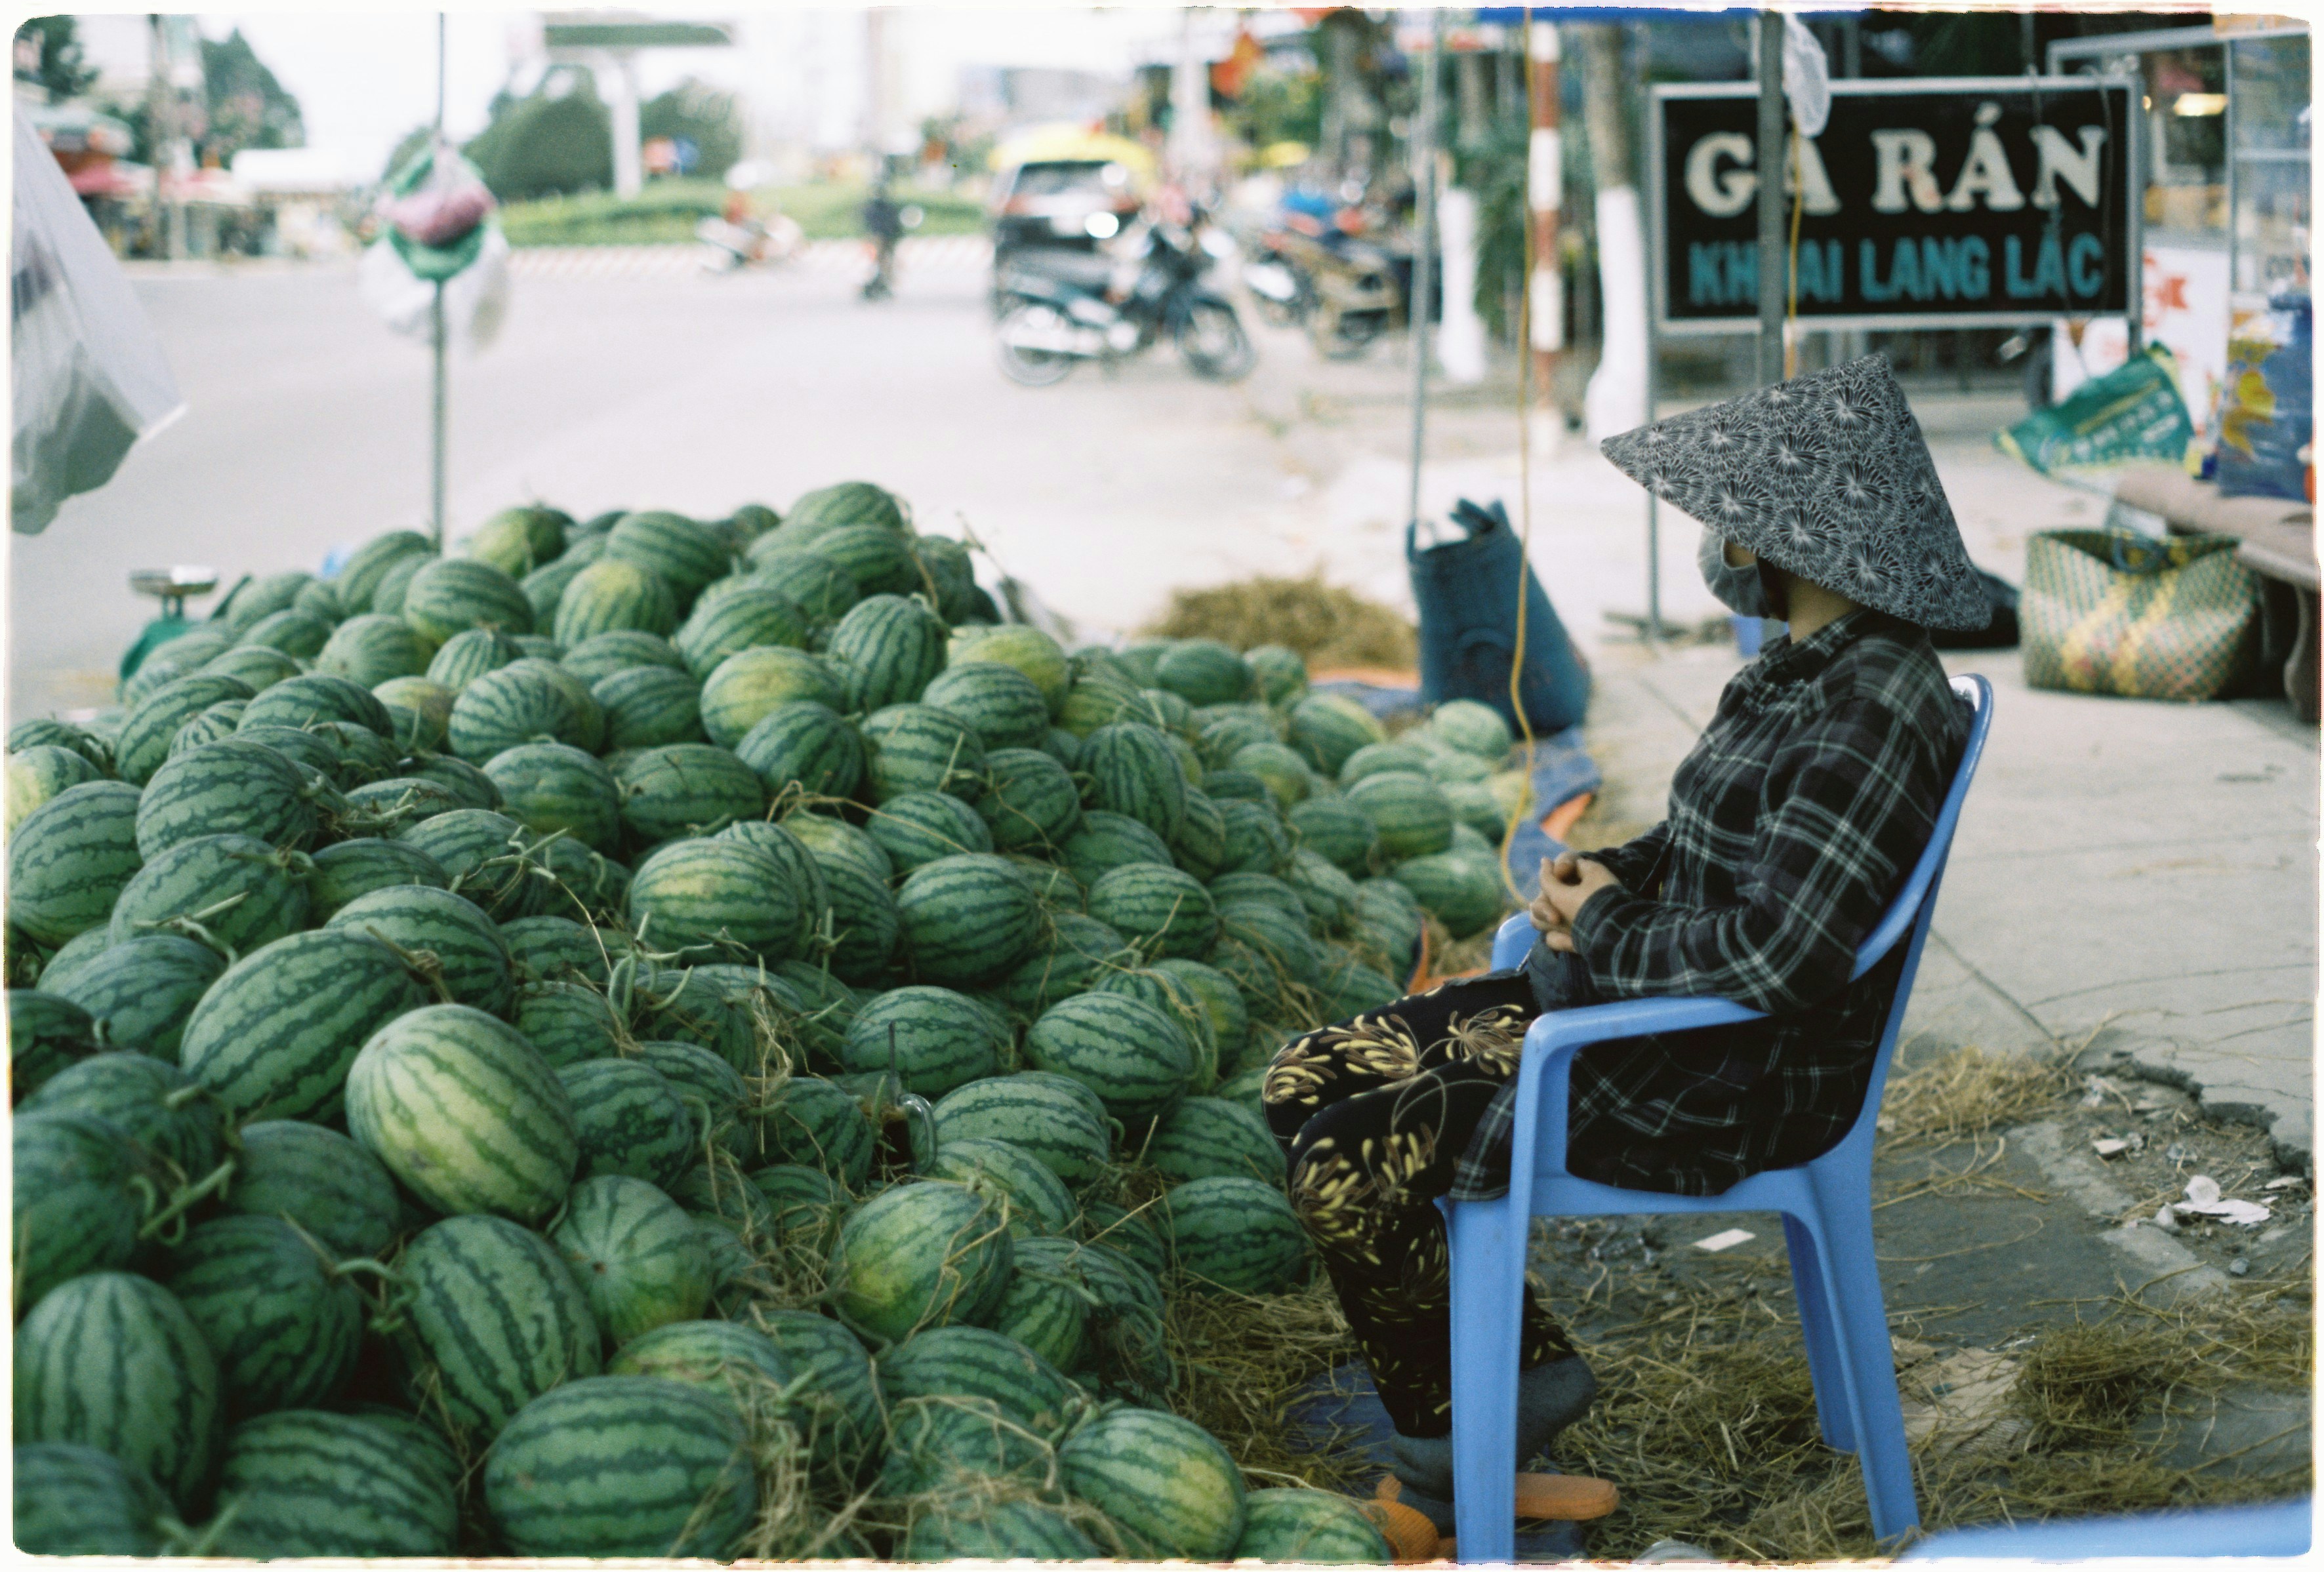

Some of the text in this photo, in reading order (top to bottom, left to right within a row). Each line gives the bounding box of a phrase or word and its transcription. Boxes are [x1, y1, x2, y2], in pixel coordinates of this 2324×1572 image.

[1869, 100, 2108, 215] RÁN
[1688, 239, 1843, 306] KHAI
[1859, 234, 1991, 302] LANG
